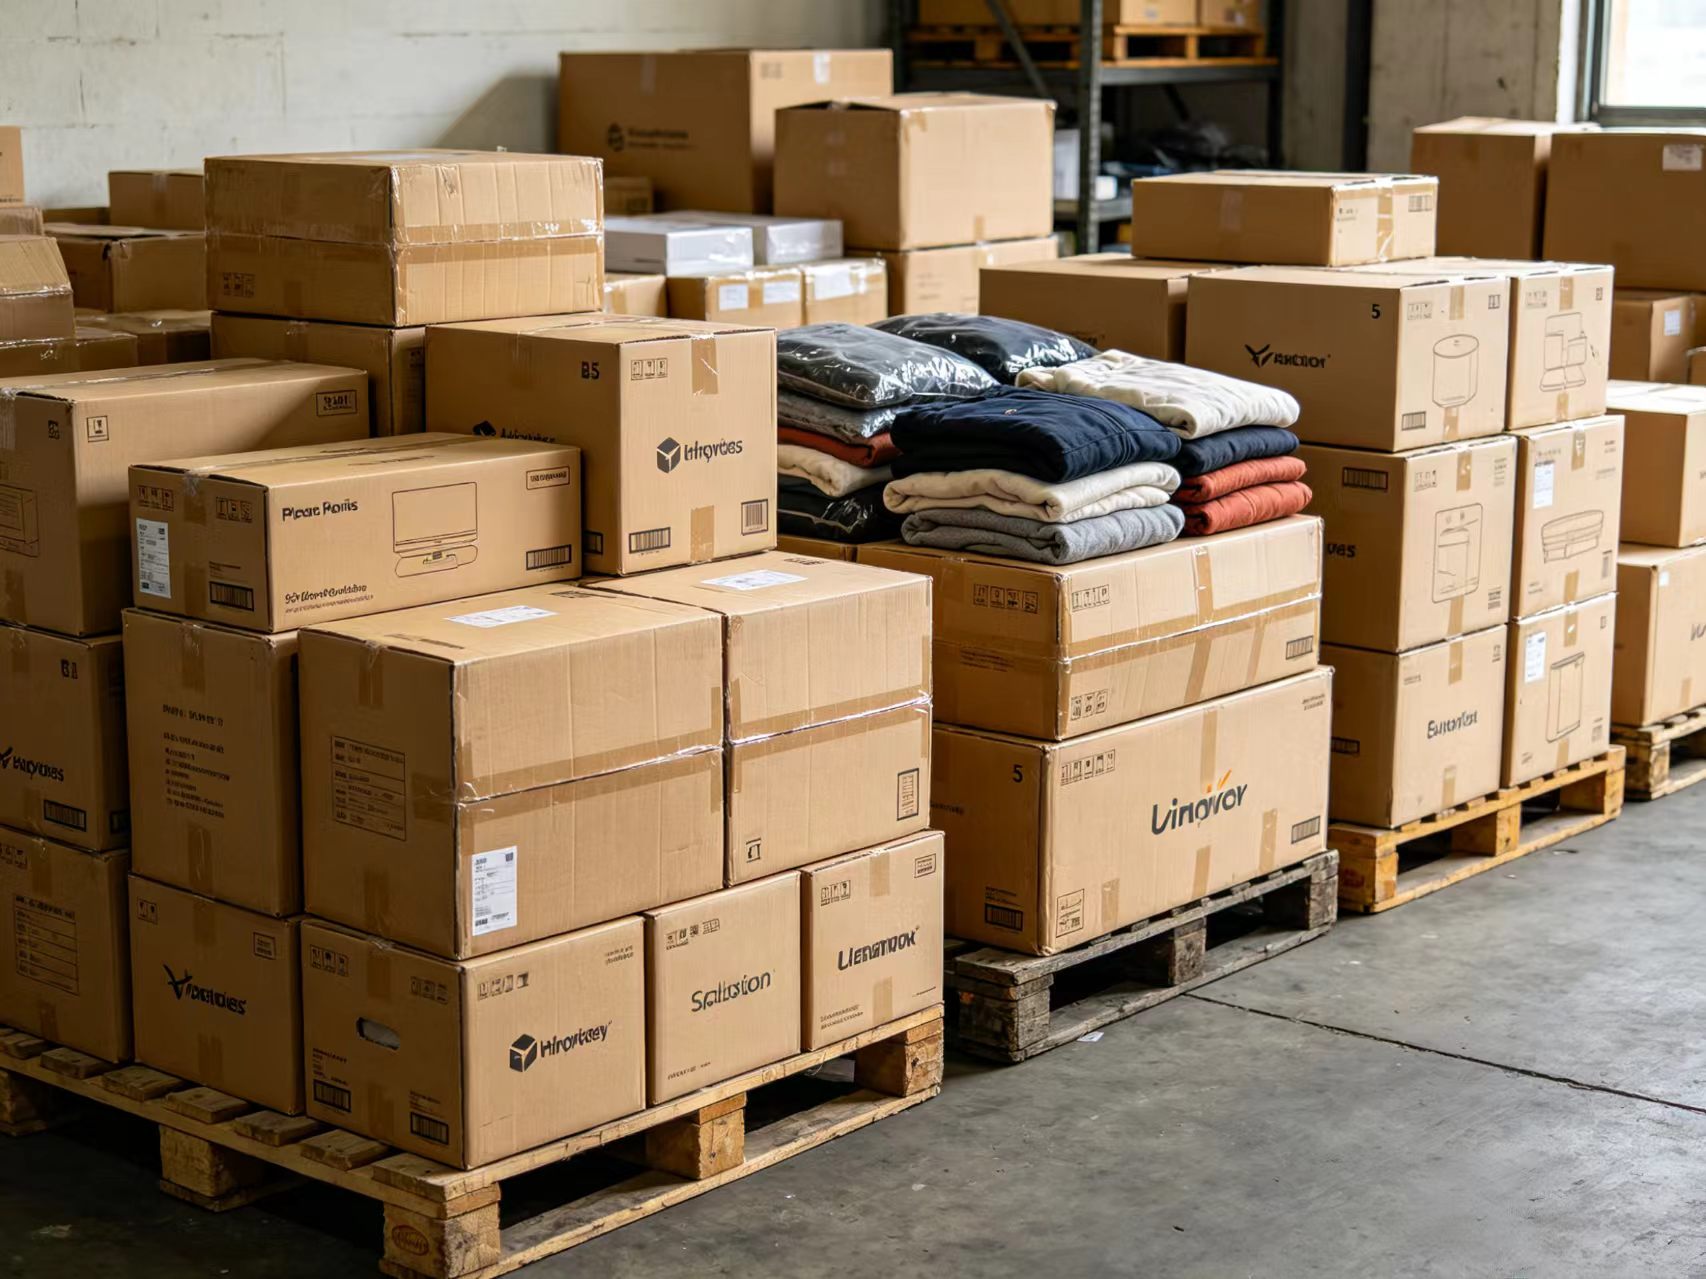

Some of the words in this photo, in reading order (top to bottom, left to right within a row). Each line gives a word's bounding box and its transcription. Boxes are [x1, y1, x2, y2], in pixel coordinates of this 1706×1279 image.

[1371, 303, 1381, 319] 5
[581, 361, 600, 379] B5
[1012, 764, 1024, 783] 5
